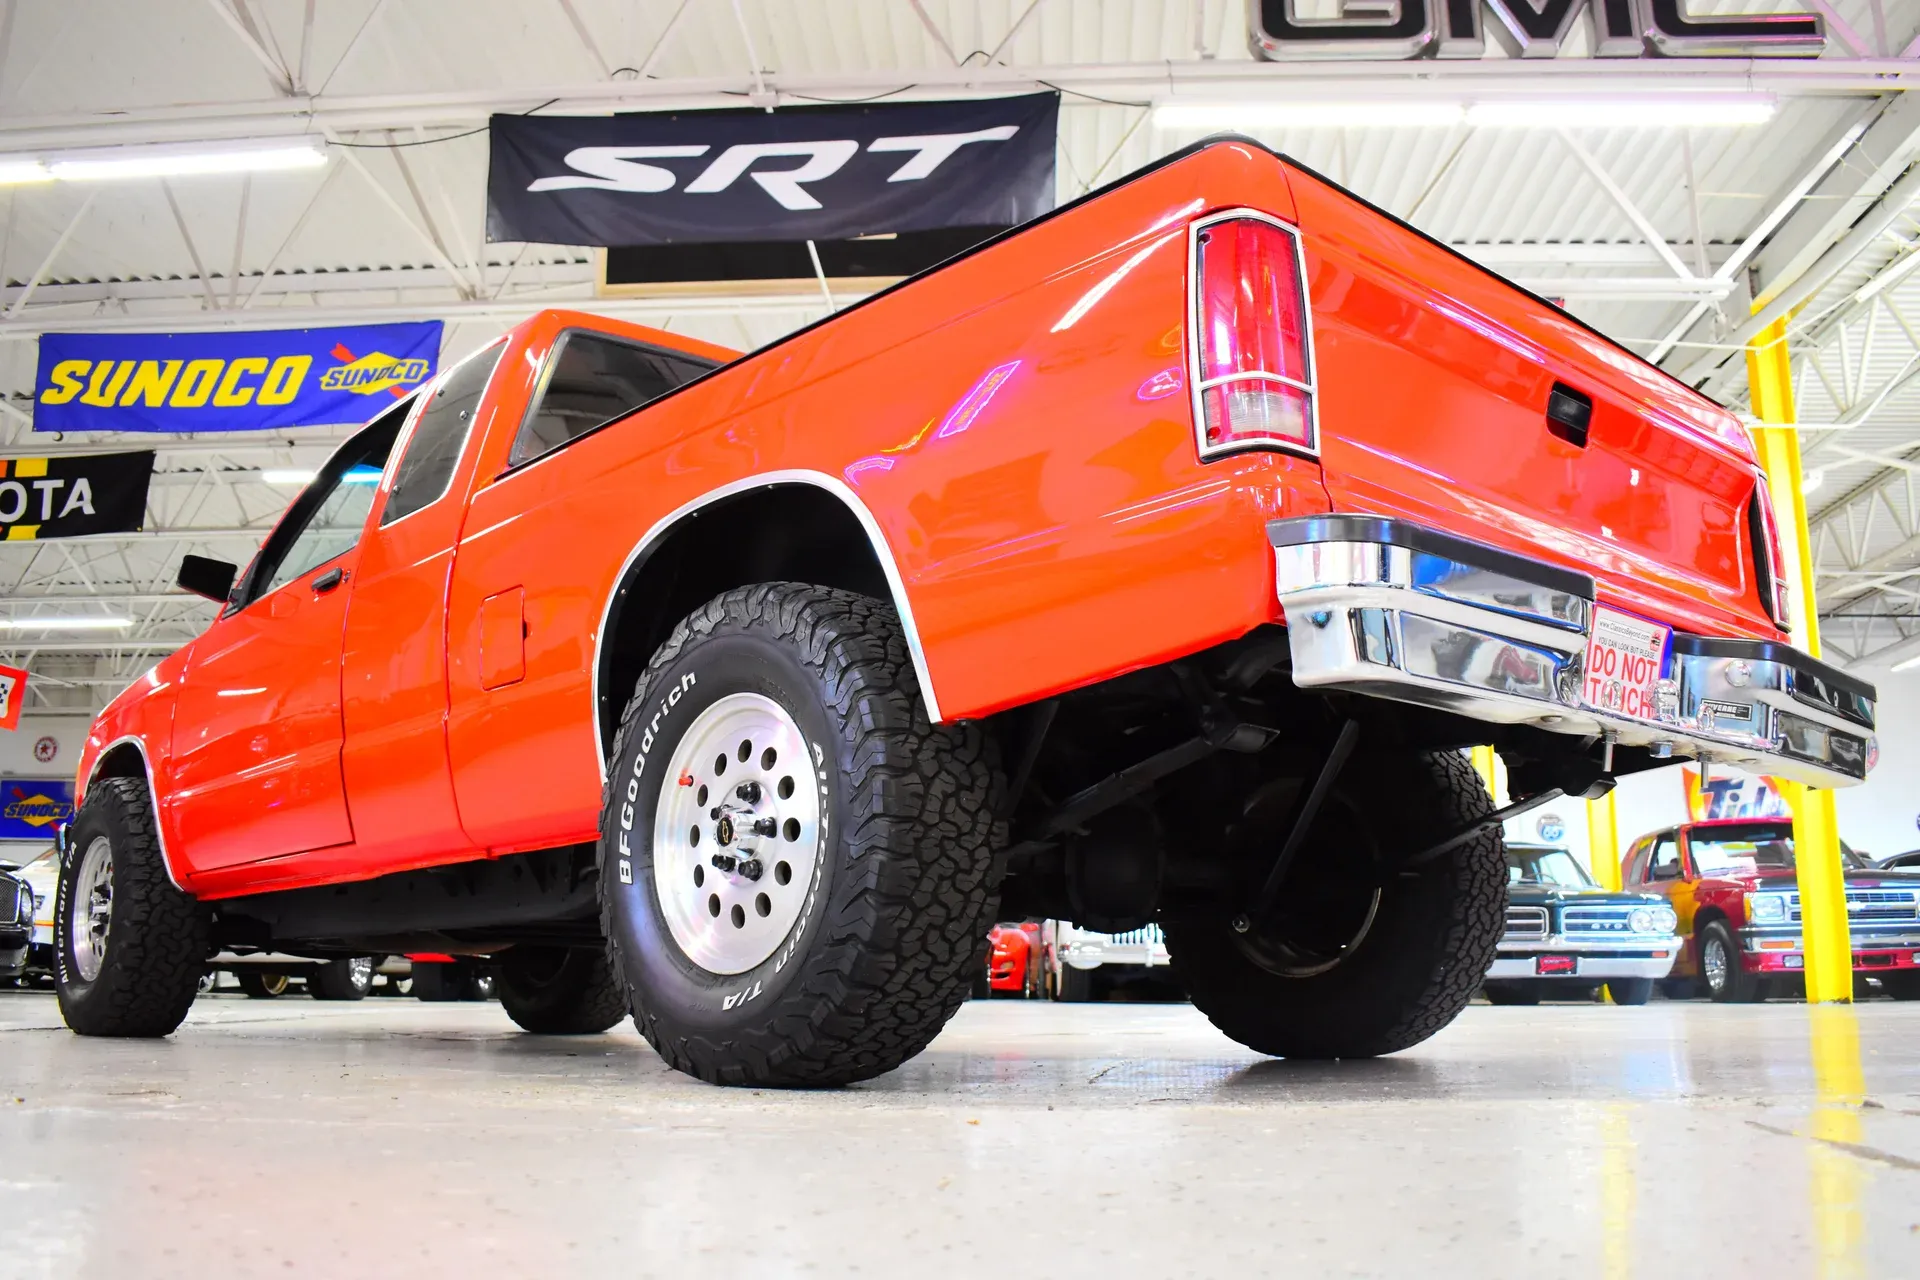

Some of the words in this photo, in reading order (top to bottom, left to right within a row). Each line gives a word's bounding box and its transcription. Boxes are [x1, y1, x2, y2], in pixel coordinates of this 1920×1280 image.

[527, 125, 1021, 211] SRT
[40, 354, 313, 408] SUNOCO
[325, 361, 425, 387] SUNOCO
[1591, 644, 1616, 677] DO
[1621, 653, 1658, 685] NOT
[1598, 636, 1607, 646] YOU
[1607, 640, 1617, 649] CAN
[1617, 643, 1629, 652] LOOK
[1630, 646, 1639, 655] BUT
[1639, 648, 1655, 660] PLEASE
[618, 671, 698, 885] BFGoodrich
[8, 804, 71, 818] SUNOCO
[775, 741, 830, 975] All-Terrain
[58, 878, 69, 984] All-Terrain
[65, 841, 77, 870] T/A
[722, 980, 763, 1011] T/A
